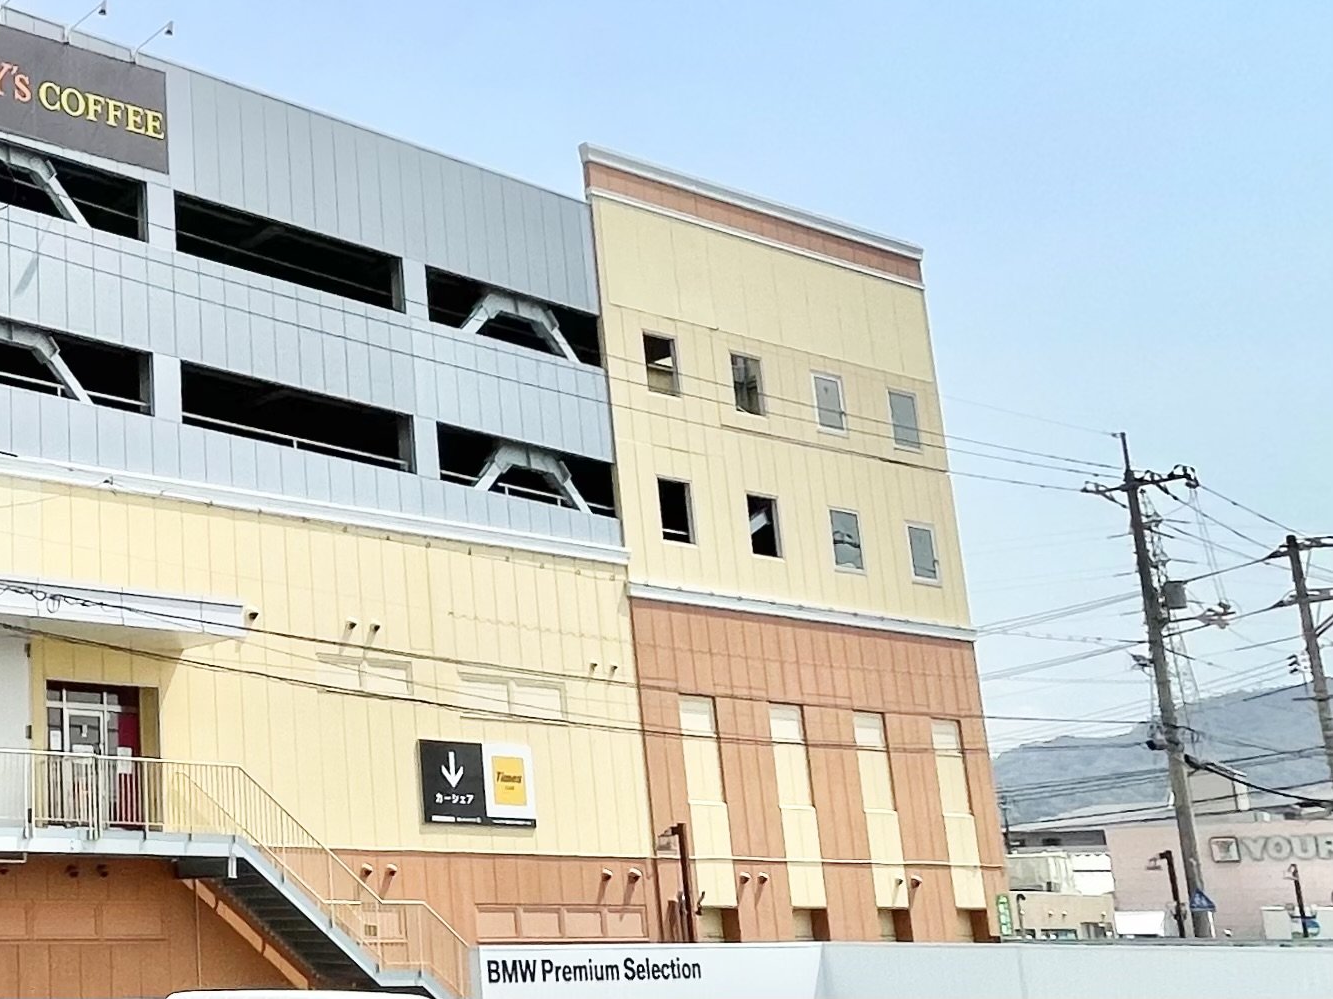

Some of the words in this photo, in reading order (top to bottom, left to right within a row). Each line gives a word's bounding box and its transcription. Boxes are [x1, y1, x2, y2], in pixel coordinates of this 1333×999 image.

[38, 81, 165, 140] COFFEE
[435, 792, 475, 805] カーシェア
[487, 960, 536, 984] BMW
[542, 957, 620, 983] Premium
[624, 957, 702, 980] Selection
